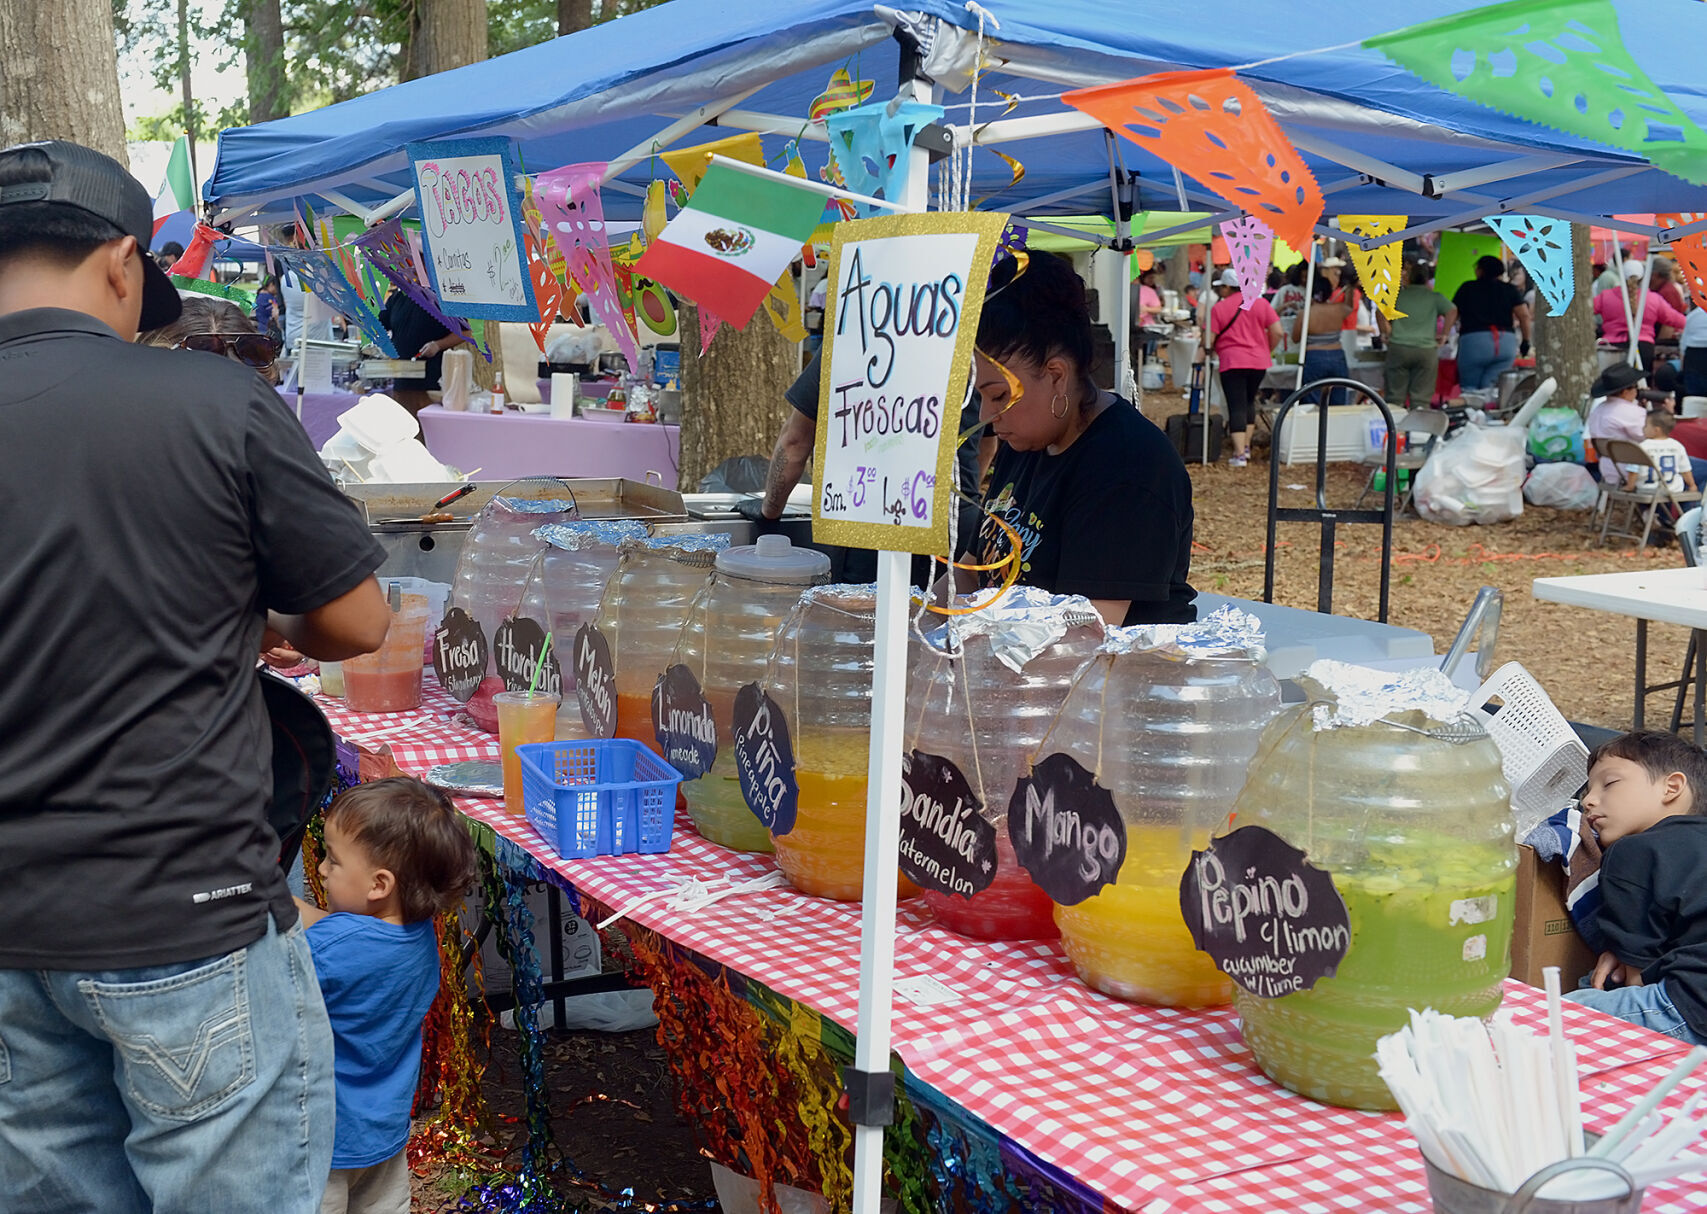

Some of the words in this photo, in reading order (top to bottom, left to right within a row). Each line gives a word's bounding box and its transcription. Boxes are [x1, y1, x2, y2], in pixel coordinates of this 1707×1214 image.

[421, 162, 504, 238] TACOS
[837, 247, 962, 389] Aguas
[834, 379, 939, 448] Frescas
[823, 482, 847, 512] Sm.
[437, 628, 480, 673] Fresa
[498, 628, 560, 695] Horchata
[656, 683, 717, 748] Limonada
[899, 828, 974, 895] atermelon
[1025, 783, 1119, 882] Mango
[1196, 851, 1309, 943] Pepino
[1223, 952, 1296, 974] cucumber
